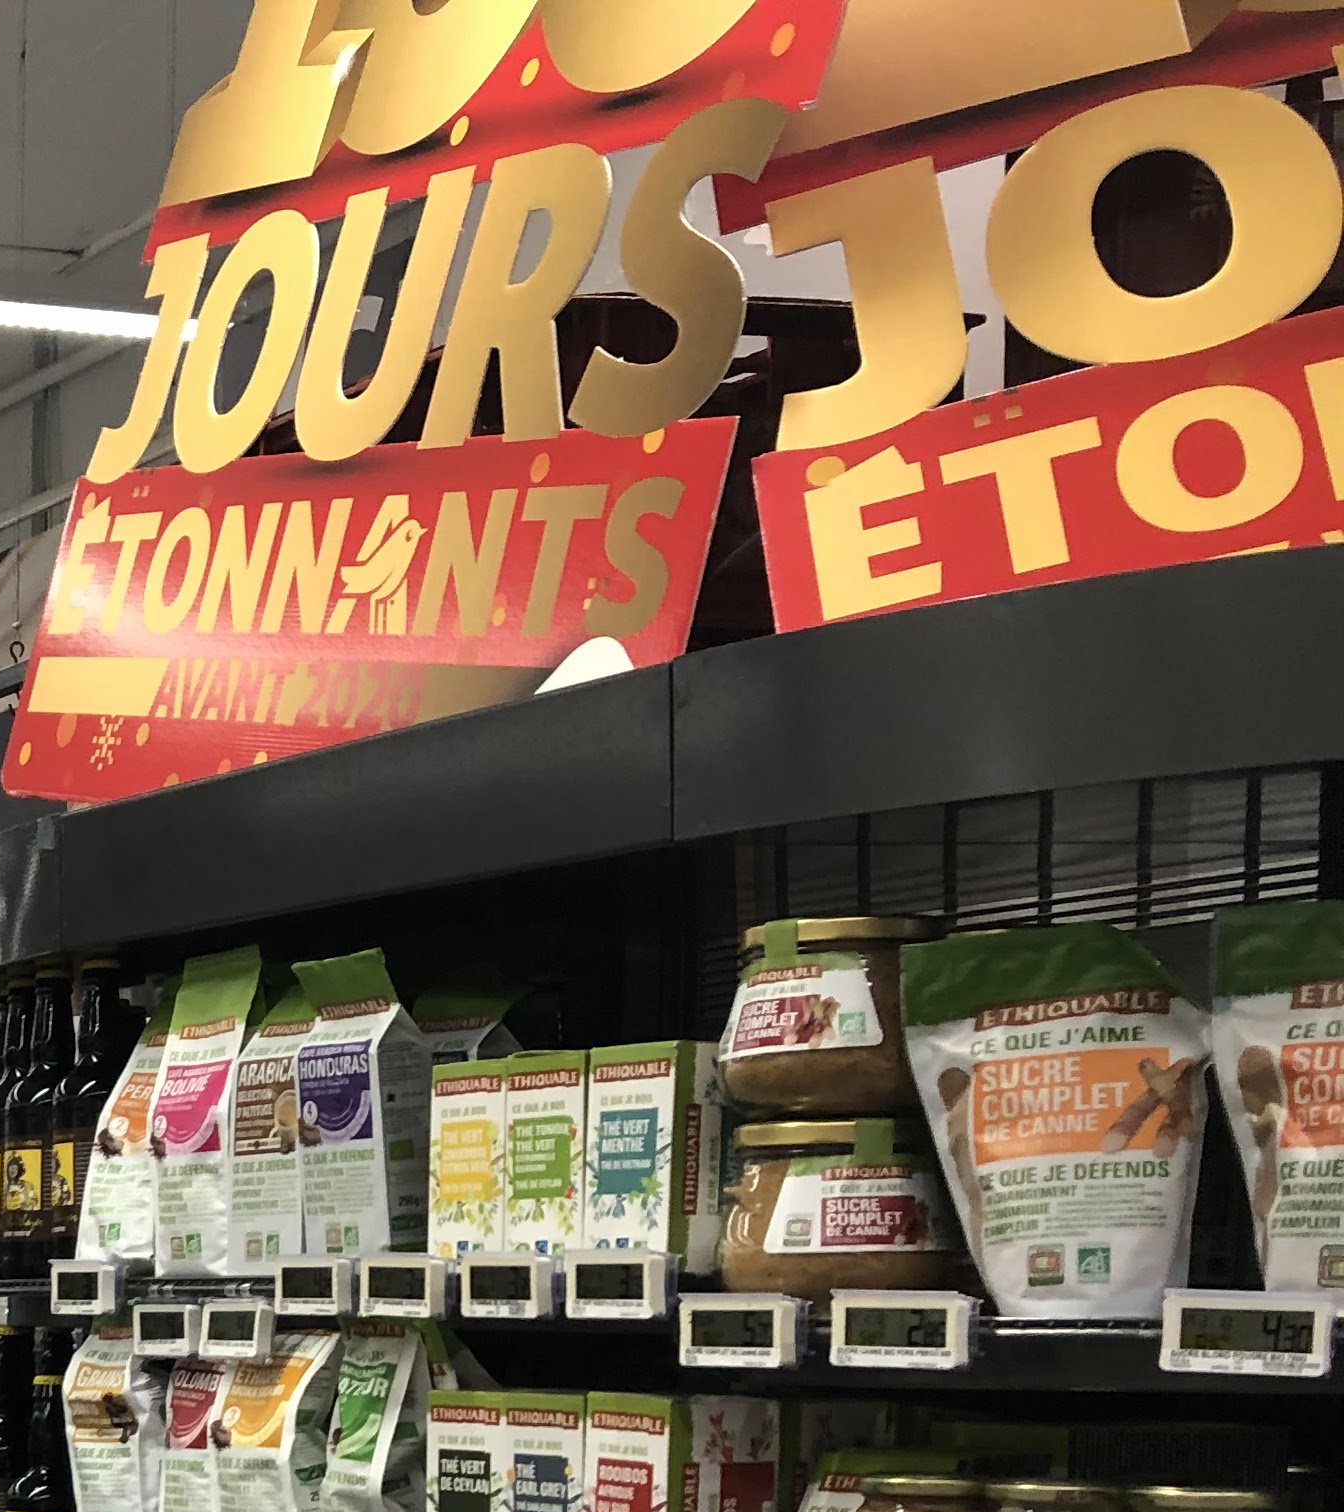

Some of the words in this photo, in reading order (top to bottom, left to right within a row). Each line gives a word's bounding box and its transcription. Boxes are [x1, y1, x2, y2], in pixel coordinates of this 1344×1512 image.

[765, 70, 1344, 452] JO
[83, 96, 788, 484] JOURS
[48, 476, 686, 638] ÉTONNANTS
[150, 657, 297, 724] AVANT
[300, 666, 423, 730] 2020
[981, 990, 1168, 1028] ETHIQUABLE
[738, 1011, 800, 1032] COMPLET
[970, 1039, 998, 1057] CE
[1005, 1033, 1051, 1051] QUE
[1059, 1025, 1146, 1045] J'AIME
[238, 1057, 295, 1087] ARABICA
[299, 1054, 368, 1081] HONDURAS
[595, 1060, 669, 1080] ETHIQUABLE
[981, 1056, 1081, 1092] SUCRE
[161, 1076, 210, 1096] BOLIVIE
[436, 1076, 500, 1094] ETHIQUABLE
[509, 1070, 578, 1090] ETHIQUABLE
[981, 1081, 1131, 1120] COMPLET
[602, 1119, 621, 1135] THÉ
[623, 1119, 650, 1135] VERT
[983, 1123, 1011, 1143] DE
[1015, 1113, 1099, 1138] CANNE
[601, 1138, 644, 1153] MENTHE
[999, 1167, 1036, 1187] QUE
[1043, 1165, 1068, 1184] JE
[1074, 1159, 1171, 1181] DÉFENDS
[826, 1199, 880, 1212] SUCRE
[826, 1211, 903, 1226] COMPLET
[826, 1225, 844, 1237] DE
[846, 1223, 890, 1237] CANNE
[433, 1407, 499, 1424] ETHIQUABLE
[508, 1411, 577, 1428] ETHIQUABLE
[593, 1413, 663, 1432] ETHIQUABLE
[441, 1458, 459, 1475] THÉ
[460, 1459, 486, 1476] VERT
[516, 1462, 536, 1479] THÉ
[599, 1464, 648, 1484] ROOIBOS
[440, 1478, 451, 1492] DE
[452, 1478, 490, 1494] CEYLAN
[516, 1480, 539, 1497] EARL
